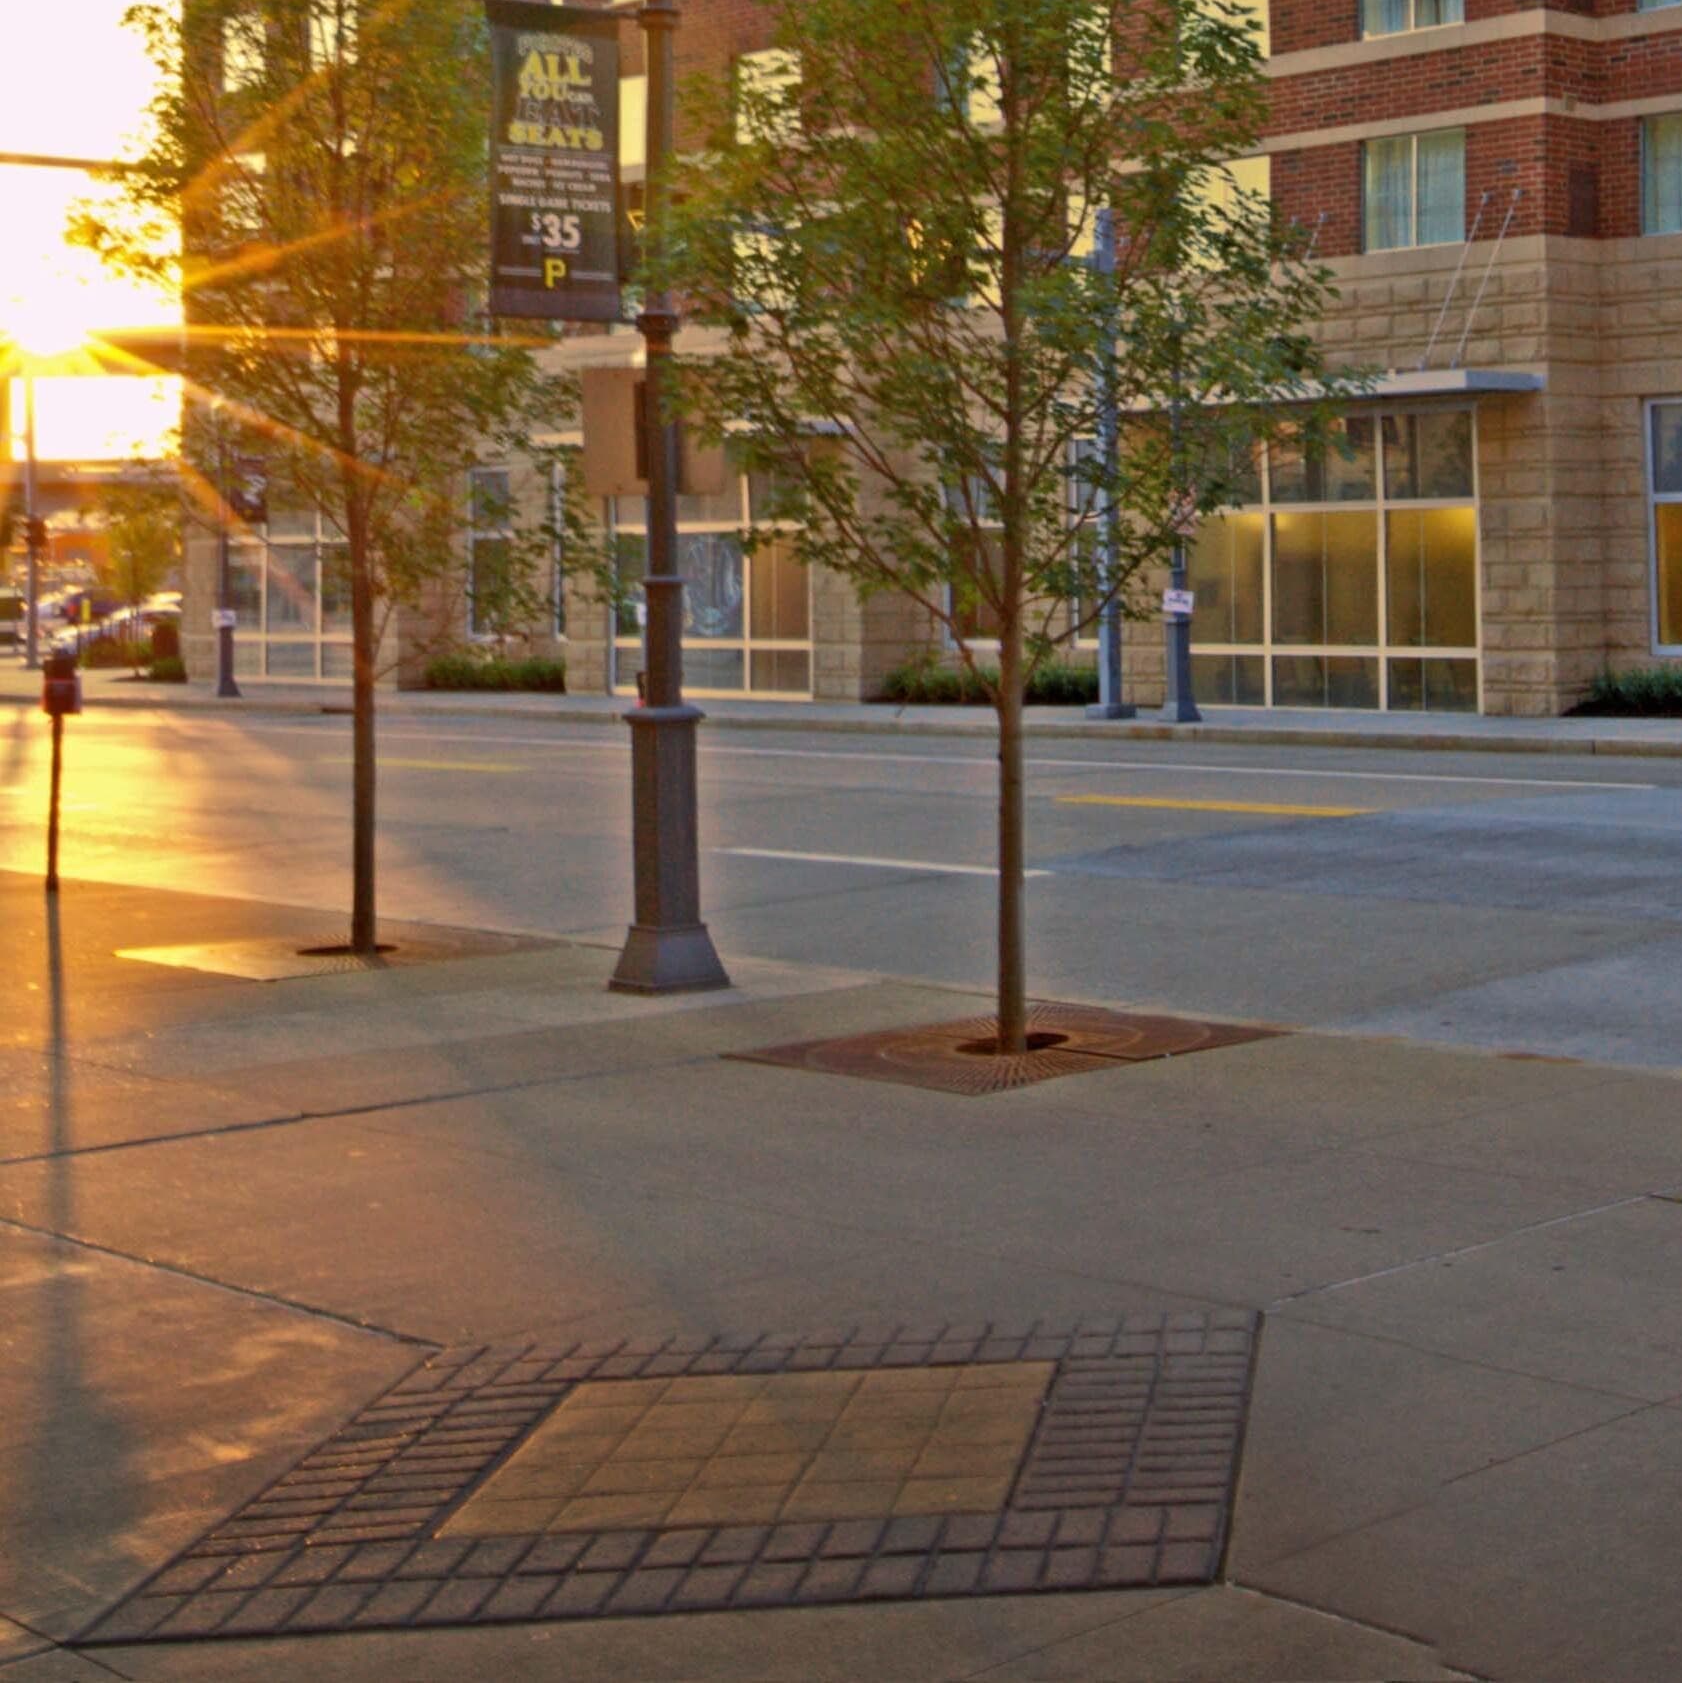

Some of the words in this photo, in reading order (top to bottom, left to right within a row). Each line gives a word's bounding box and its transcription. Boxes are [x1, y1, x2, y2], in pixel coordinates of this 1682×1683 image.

[519, 49, 592, 86] ALL
[519, 75, 568, 100] YOU
[508, 120, 603, 151] SEATS
[544, 258, 567, 289] P
